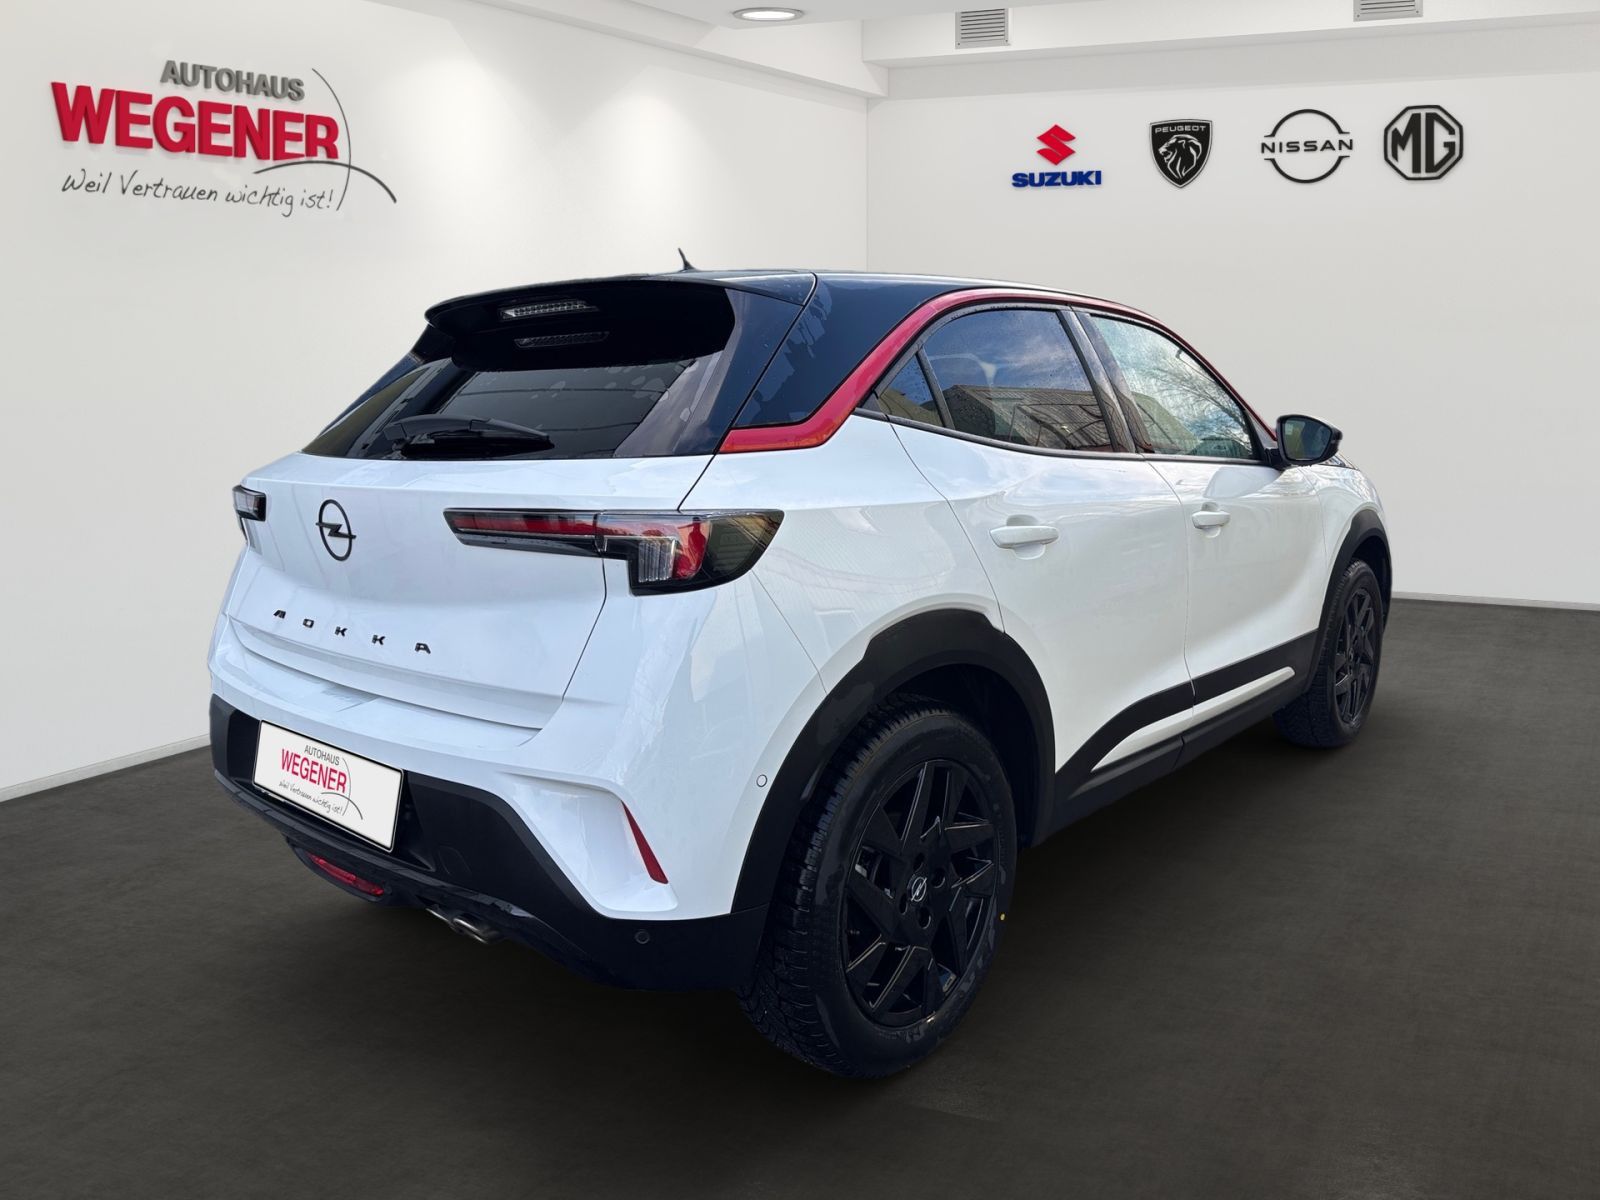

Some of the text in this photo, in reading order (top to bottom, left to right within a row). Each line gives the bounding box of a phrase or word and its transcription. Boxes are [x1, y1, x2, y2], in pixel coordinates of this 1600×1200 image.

[161, 60, 305, 101] AUTOHAUS
[51, 81, 339, 161] WEGENER
[1155, 125, 1206, 133] PEUGEOT
[1261, 139, 1353, 154] NISSAN
[1392, 112, 1456, 174] MG
[61, 169, 334, 217] Weil Vertrauen wichtig ist!
[1012, 170, 1102, 188] SUZUKI
[282, 749, 347, 793] WEGENER
[305, 745, 340, 765] AUTOHAUS
